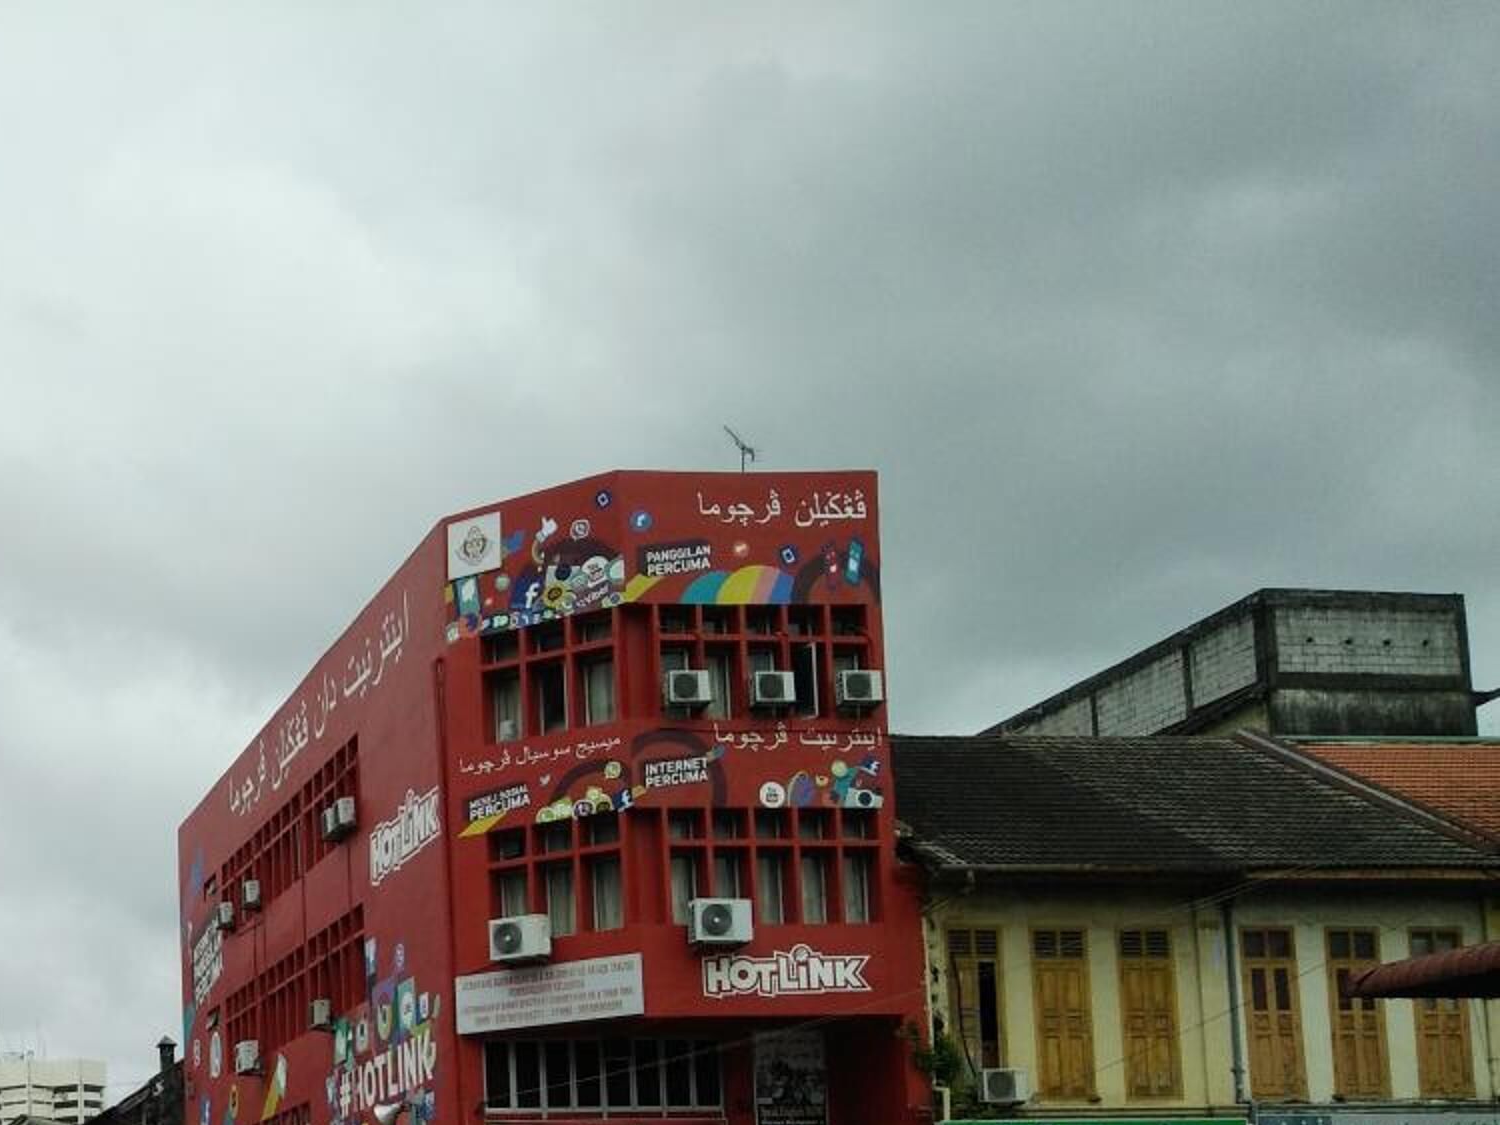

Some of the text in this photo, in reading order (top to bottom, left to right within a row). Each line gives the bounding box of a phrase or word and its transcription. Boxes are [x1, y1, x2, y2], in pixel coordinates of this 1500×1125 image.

[646, 544, 711, 563] PANGGILAN
[647, 556, 711, 577] PERCUMA
[645, 757, 709, 776] INTERNET
[645, 771, 709, 788] PERCUMA
[469, 793, 531, 821] PERCUMA
